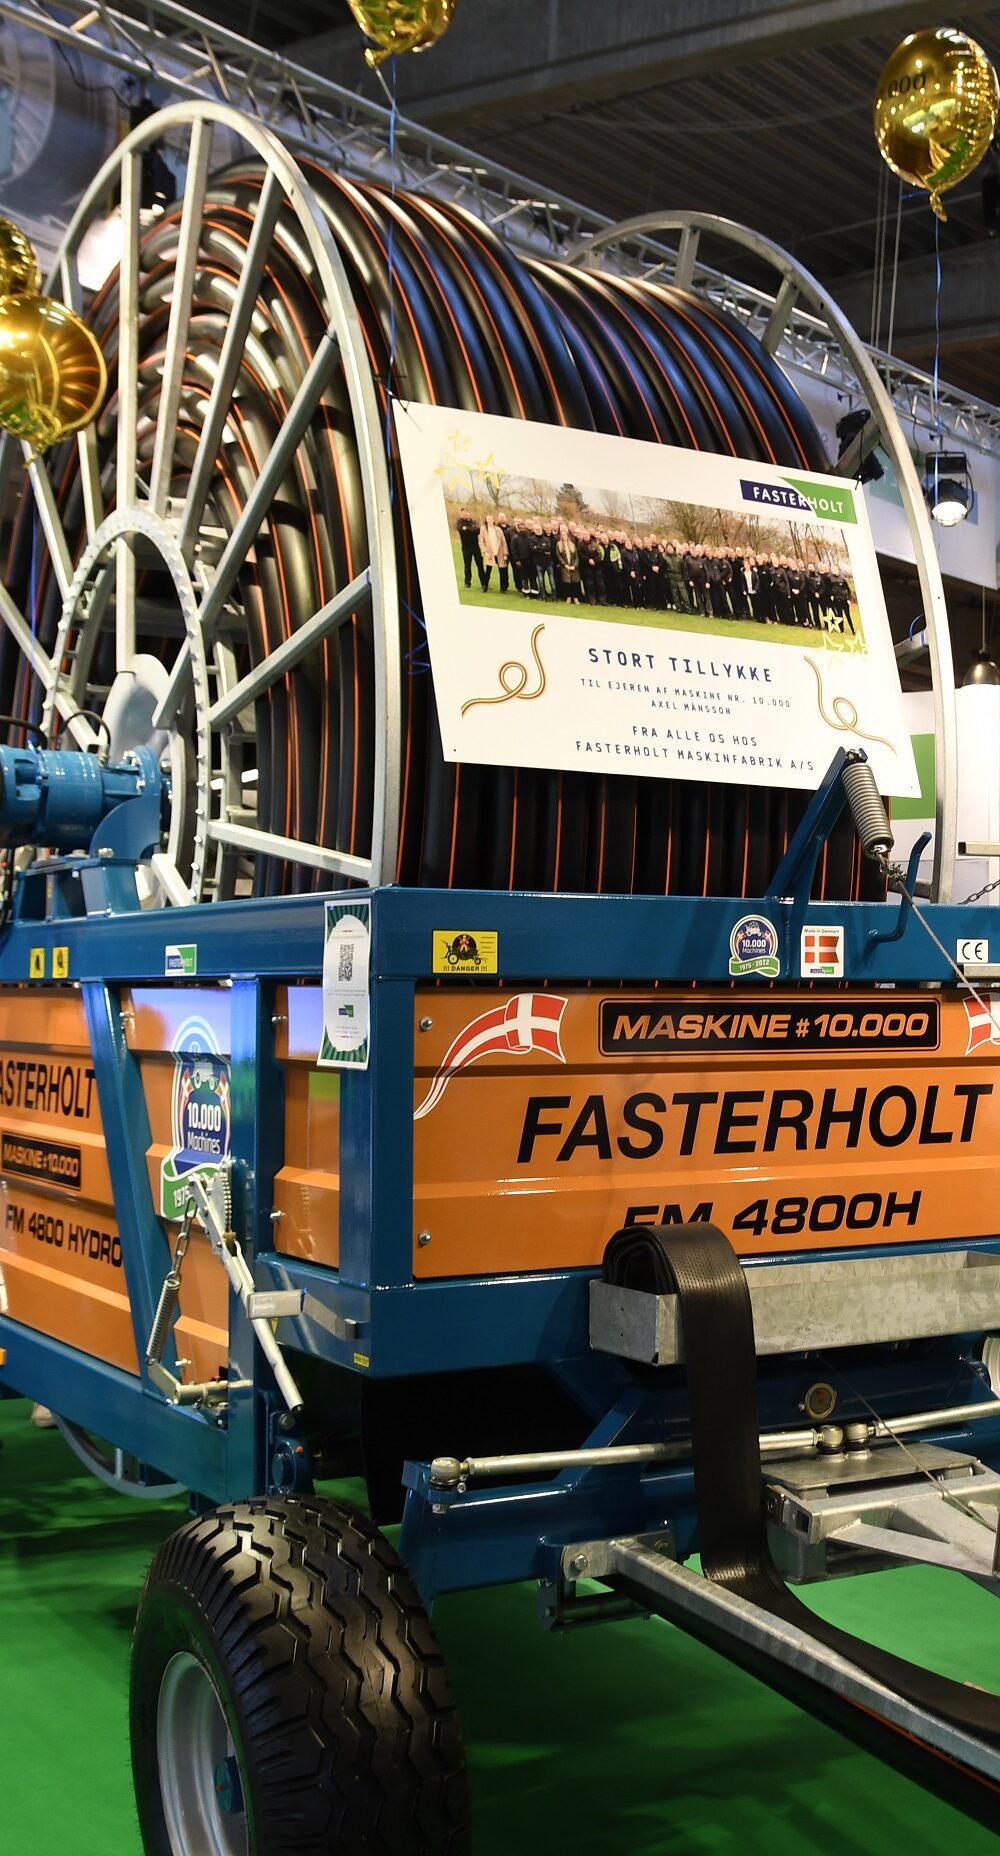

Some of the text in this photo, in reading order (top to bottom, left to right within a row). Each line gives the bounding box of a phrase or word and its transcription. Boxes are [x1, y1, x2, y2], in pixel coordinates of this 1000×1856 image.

[753, 487, 843, 514] FASTERHOLT
[588, 648, 772, 683] STORT TILLYKKE
[580, 678, 791, 708] TIL EJEREN AF MASKINE NR. 10.000
[651, 700, 731, 715] AXEL MÅNSSON
[632, 726, 757, 747] FRA ALLE OS HOS
[576, 741, 814, 771] FASTERHOLT MASKINFABRIK A/S
[742, 939, 767, 948] 10.000
[742, 946, 767, 954] Machines
[962, 942, 983, 960] CE
[612, 1014, 791, 1040] MASKINE
[187, 1102, 221, 1132] 10.000
[516, 1083, 994, 1164] FASTERHOLT
[3, 1143, 43, 1169] MASKINE
[187, 1131, 221, 1155] Machines
[732, 1190, 922, 1236] 4800H
[5, 1204, 123, 1268] FM 4800 HYDRO
